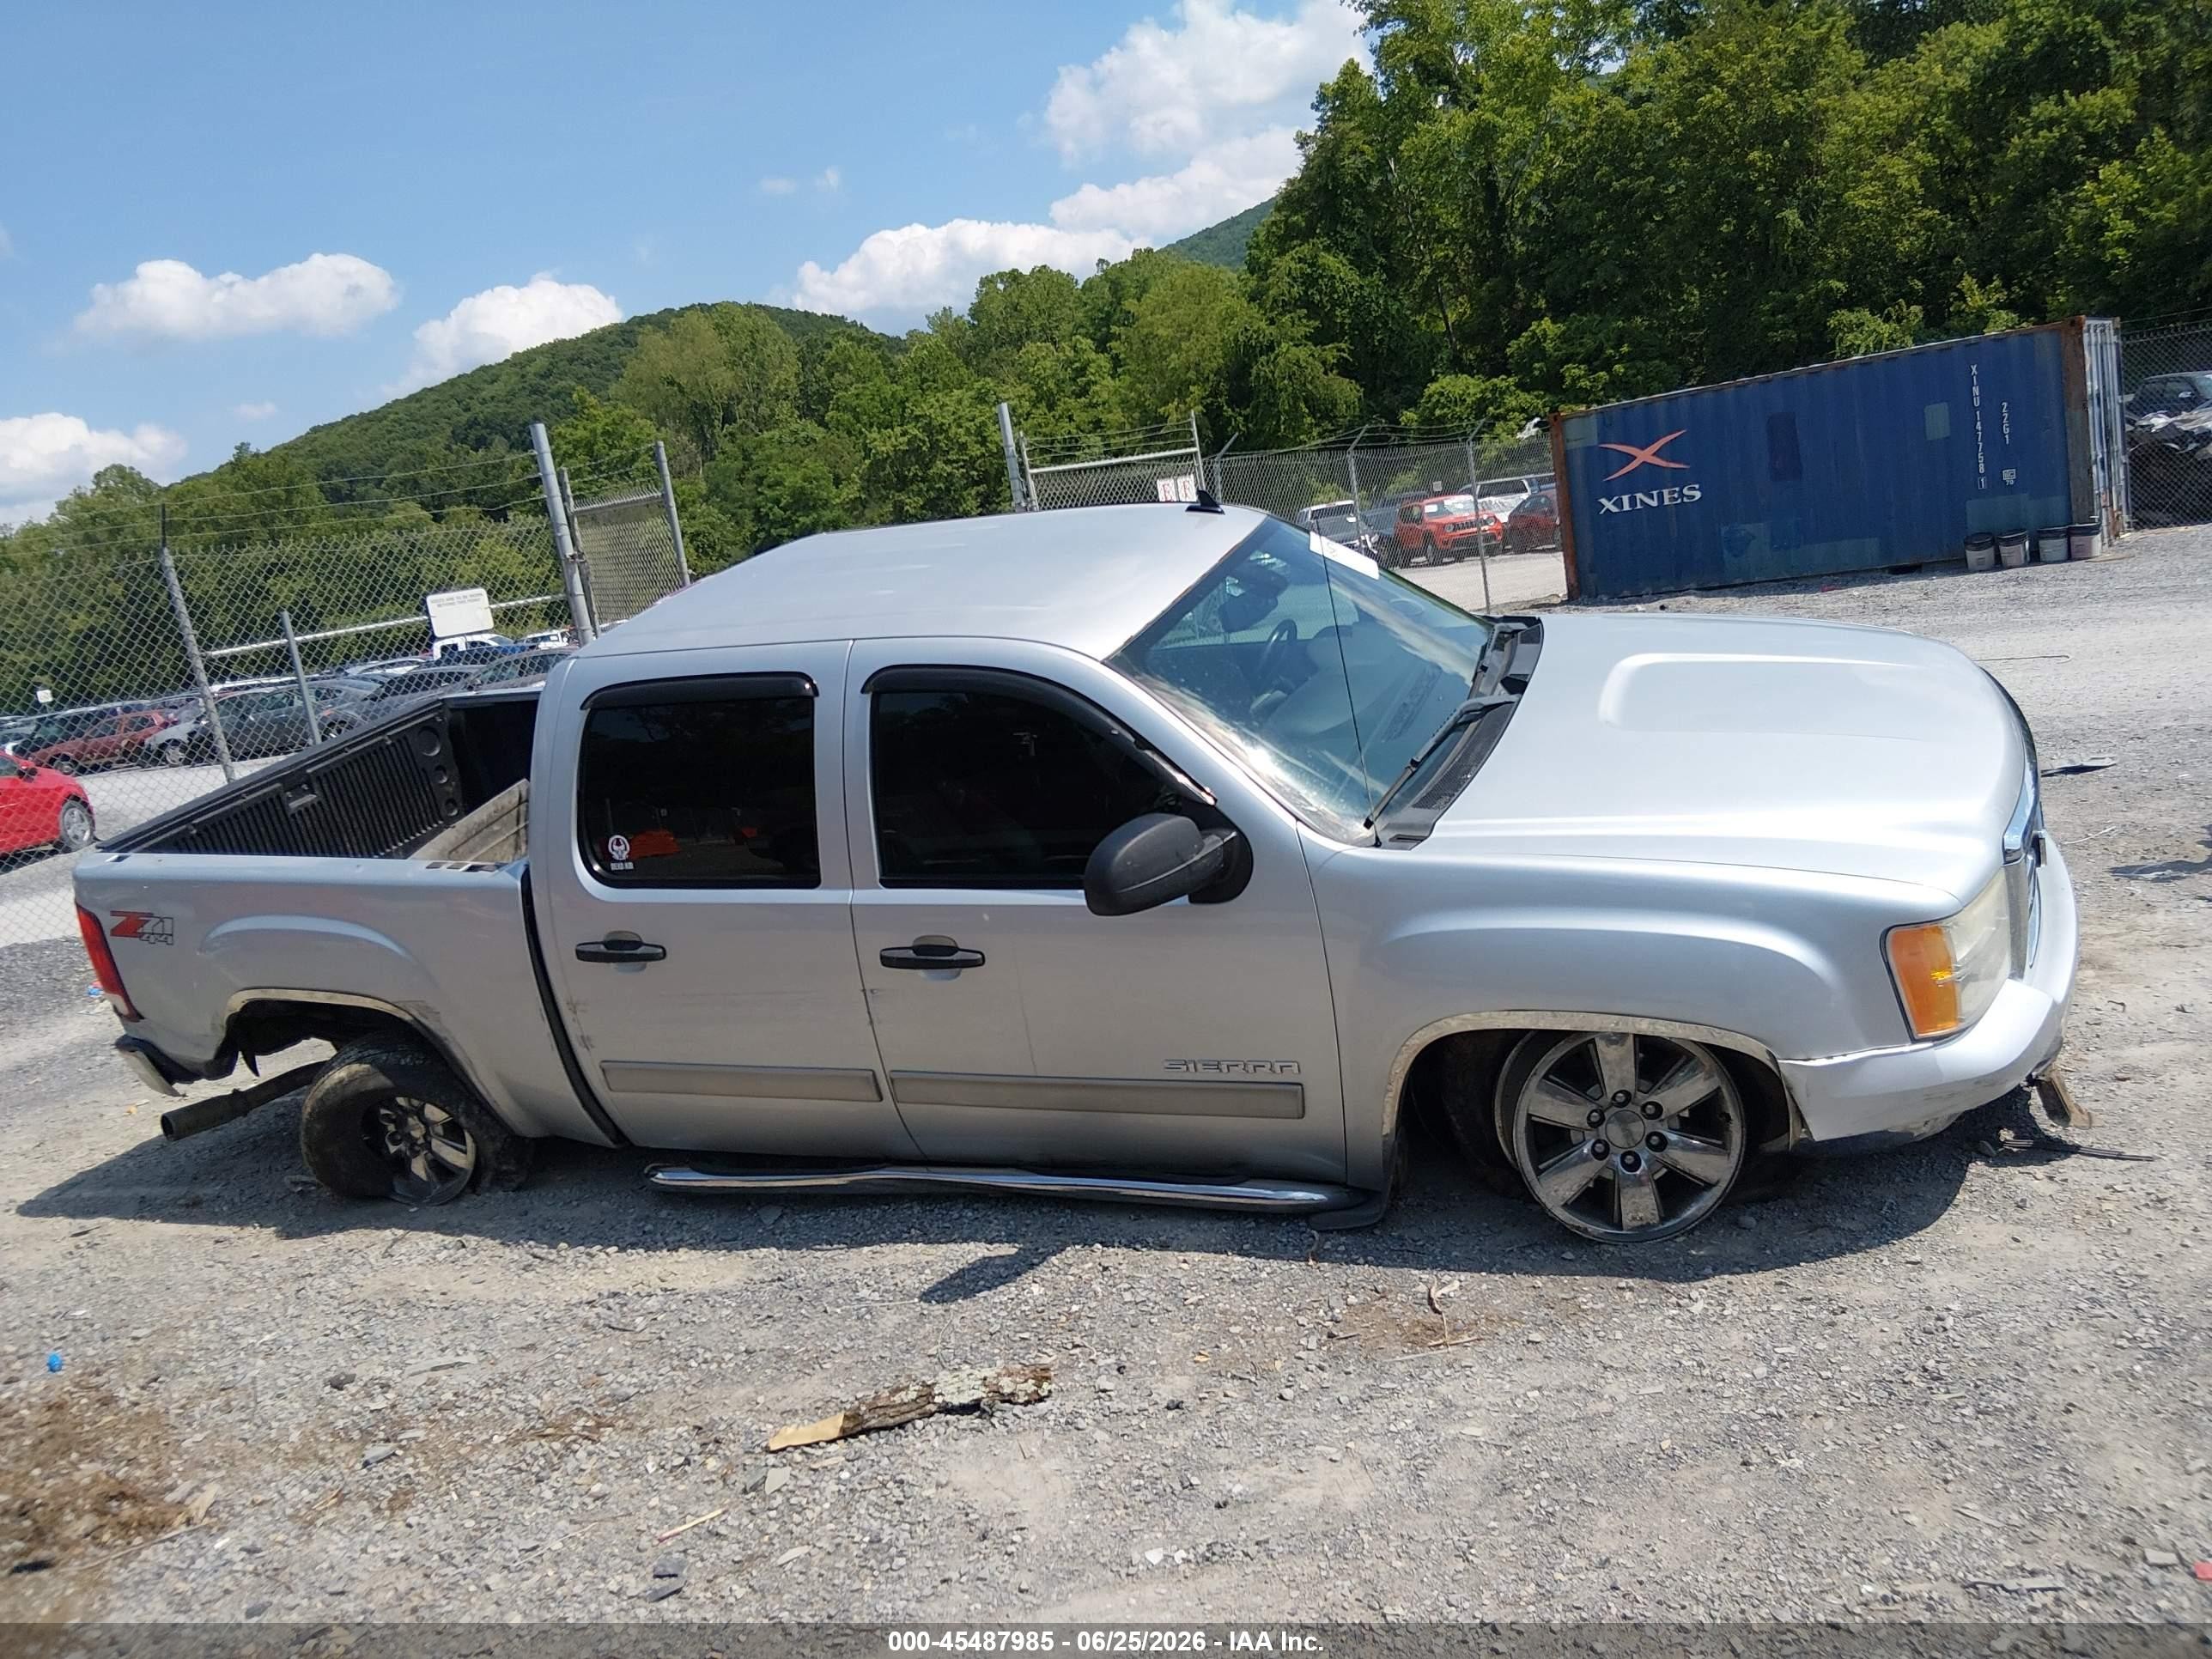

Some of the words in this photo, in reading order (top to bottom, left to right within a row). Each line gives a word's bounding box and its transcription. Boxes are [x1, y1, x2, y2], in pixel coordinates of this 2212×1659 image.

[1970, 364, 1980, 408] XINU
[1975, 410, 1985, 474] 147758
[2001, 402, 2010, 445] 22G1
[1597, 484, 1702, 515] XINES
[110, 910, 173, 939] Z71
[1164, 1059, 1302, 1074] SIERRA
